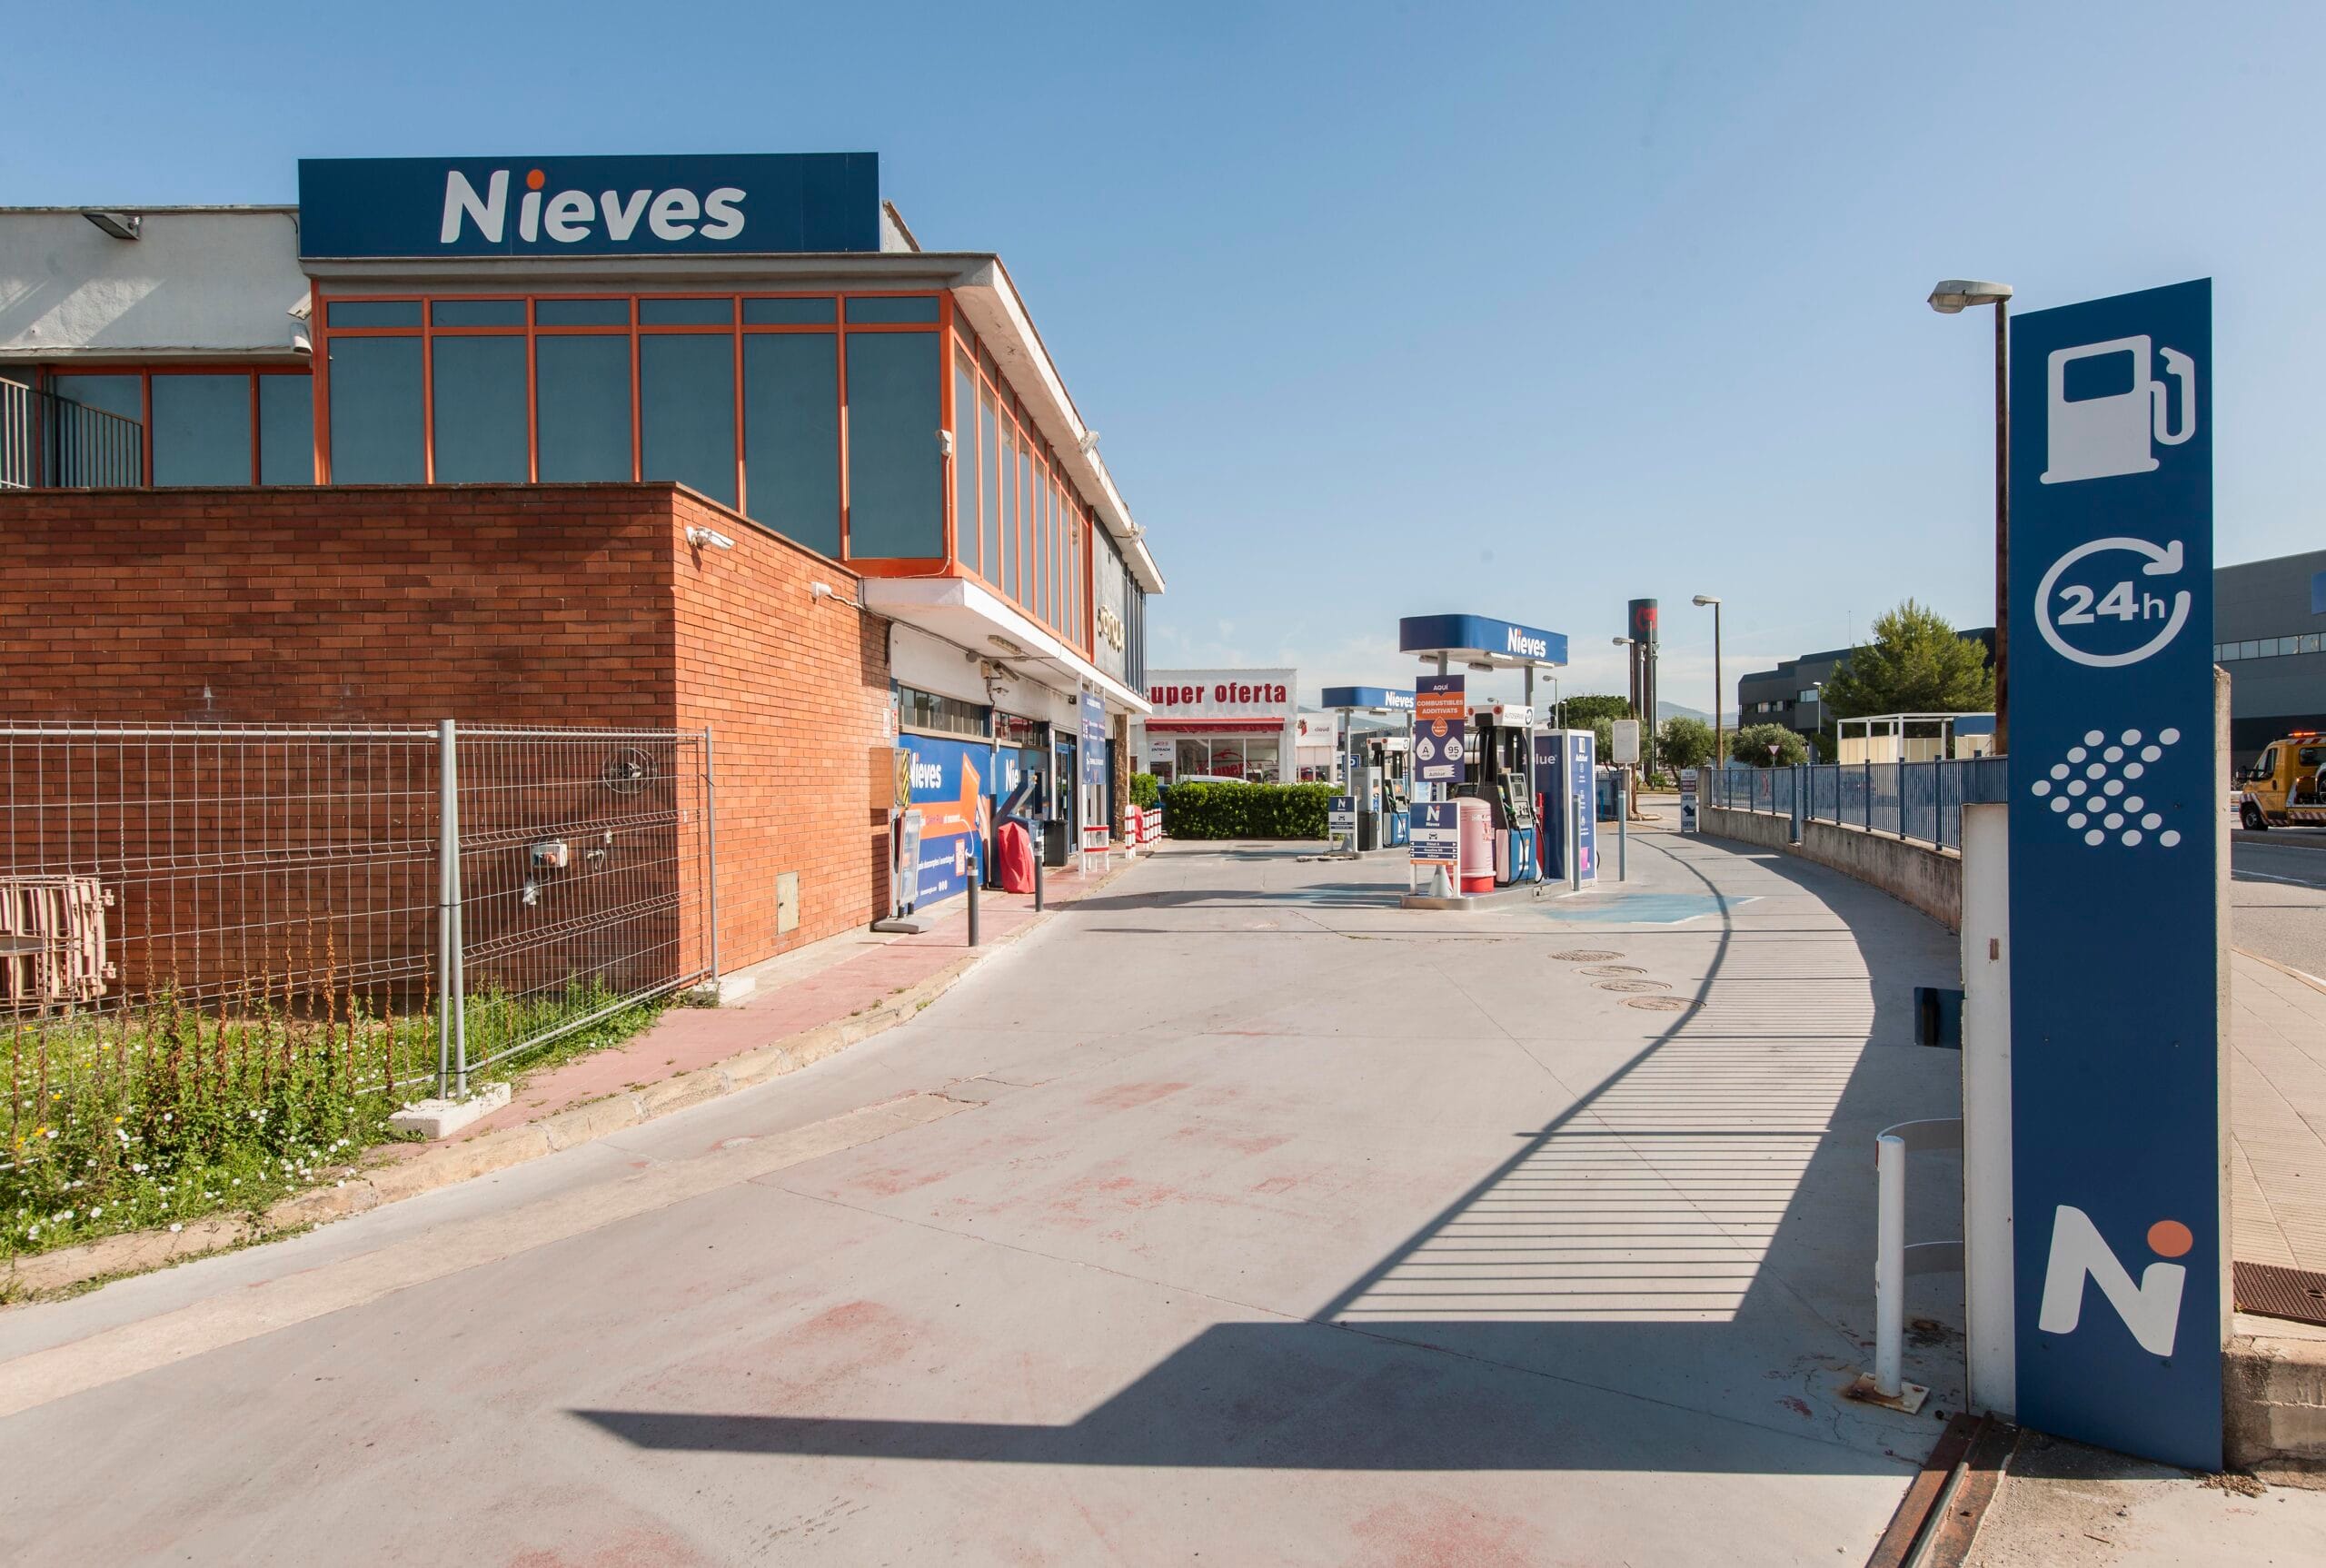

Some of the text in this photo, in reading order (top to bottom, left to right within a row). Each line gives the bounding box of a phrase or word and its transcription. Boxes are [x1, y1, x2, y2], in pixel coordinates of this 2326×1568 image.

[441, 169, 747, 243] Nieves
[2058, 581, 2165, 625] 24h
[1507, 627, 1546, 658] Nieves
[1147, 682, 1287, 706] uper oferta
[1385, 690, 1414, 709] Nieves
[1447, 746, 1459, 754] 95
[910, 751, 942, 789] Nieves
